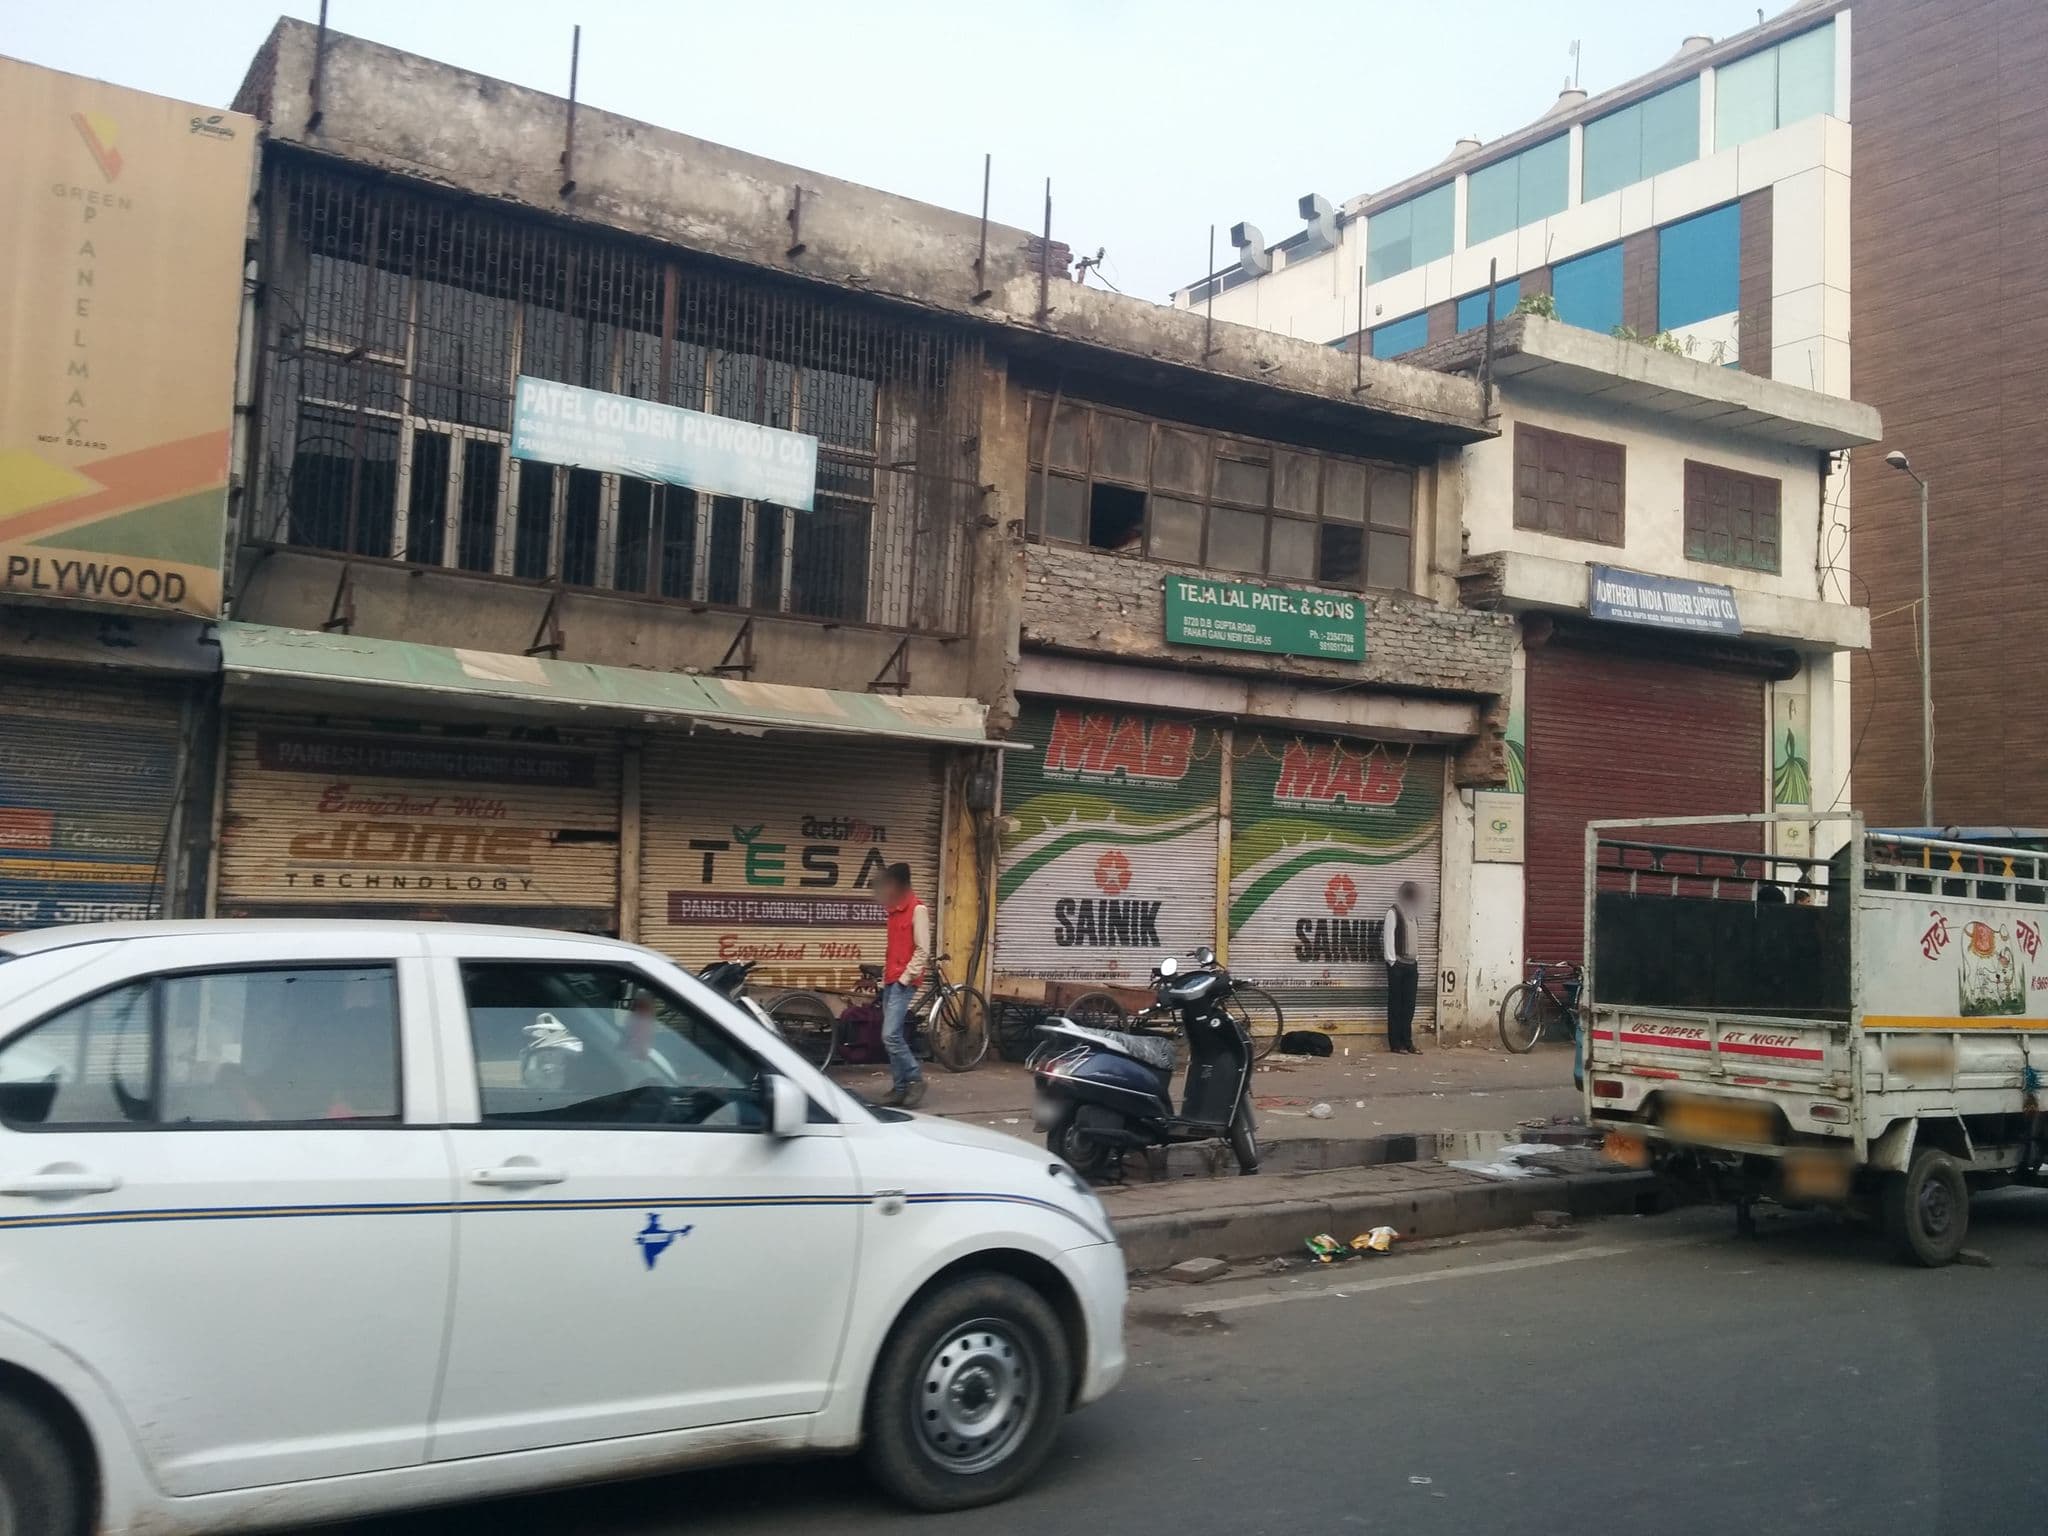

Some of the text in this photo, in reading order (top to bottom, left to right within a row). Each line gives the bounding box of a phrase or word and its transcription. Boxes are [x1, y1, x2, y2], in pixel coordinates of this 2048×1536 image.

[51, 183, 132, 210] GREEN
[522, 383, 586, 421] PATEL
[593, 398, 676, 440] GOLDEN
[683, 415, 774, 459] PLYWOOD
[66, 438, 108, 450] BOARD
[7, 554, 187, 604] PLYWOOD
[1178, 583, 1217, 605] TEJA
[1220, 588, 1249, 608] LAL
[1300, 598, 1311, 615] &
[1314, 600, 1355, 620] SONS
[1638, 588, 1663, 611] INDIA
[1663, 591, 1694, 615] TIMBER
[1693, 595, 1721, 618] SUPPLY
[1214, 620, 1236, 631] GUPTA
[1237, 623, 1256, 634] ROAD
[1227, 632, 1242, 643] NEW
[1042, 709, 1196, 780] MAB
[1273, 743, 1408, 806] MAB
[689, 838, 888, 889] TESA
[286, 873, 533, 892] TECHNOLOGY
[681, 900, 738, 918] PANELS
[746, 901, 808, 920] FLOORING
[816, 903, 849, 920] DOOR
[1054, 898, 1162, 947] SAINIK
[718, 934, 862, 960] Enriched With
[1920, 911, 1951, 961] राधे
[2016, 920, 2042, 964] राधे
[1441, 970, 1456, 993] 19
[1631, 1022, 1799, 1047] USE DIPPER AT NIGHT
